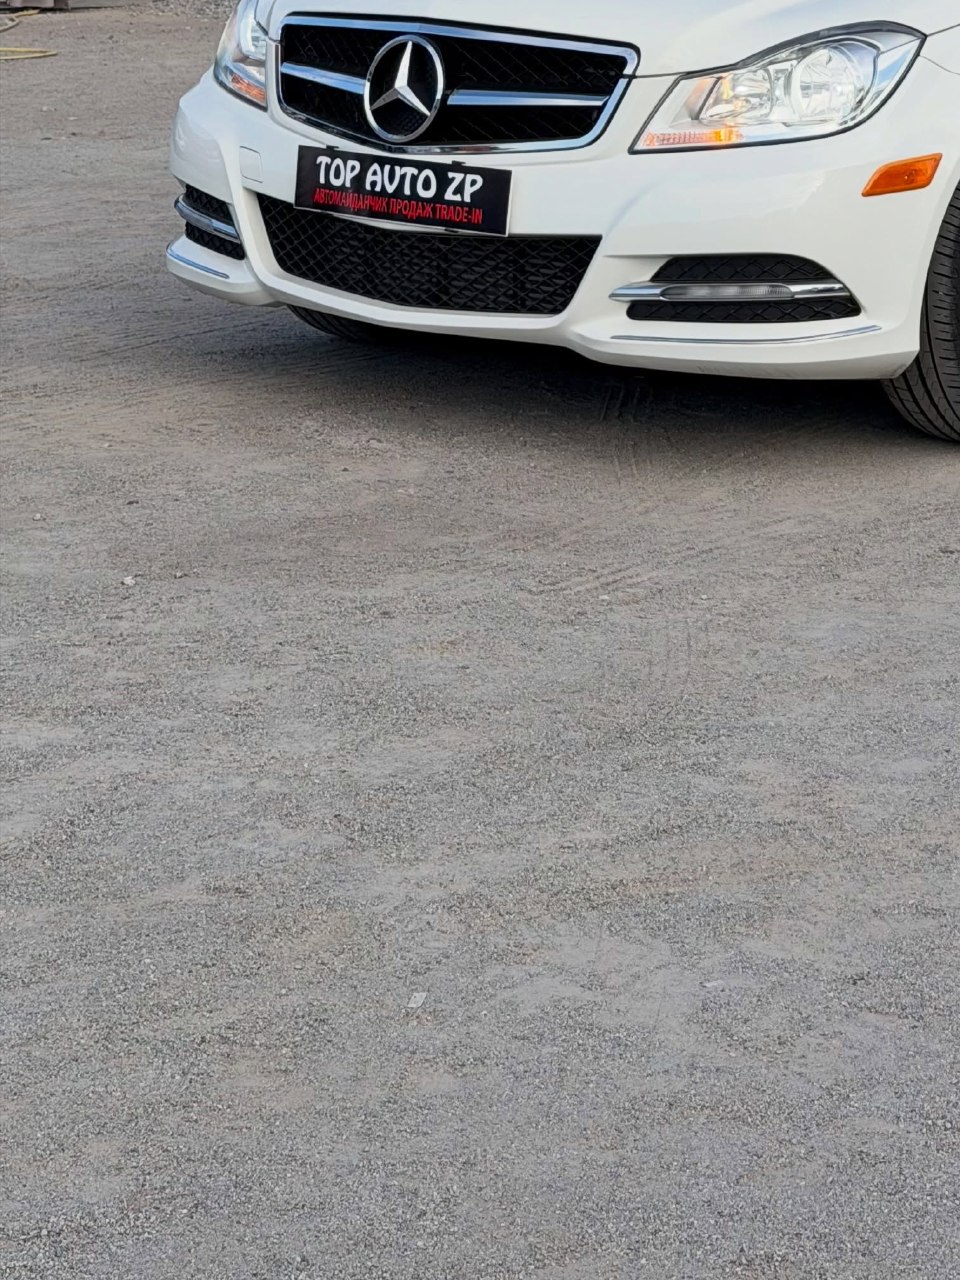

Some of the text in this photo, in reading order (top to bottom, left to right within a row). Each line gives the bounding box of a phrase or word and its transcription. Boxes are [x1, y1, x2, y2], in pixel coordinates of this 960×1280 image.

[316, 155, 361, 188] TOP
[444, 171, 483, 203] ZP
[313, 187, 483, 224] АВТОМАЙДАНЧИК ПРОДАЖ TRADE-IN
